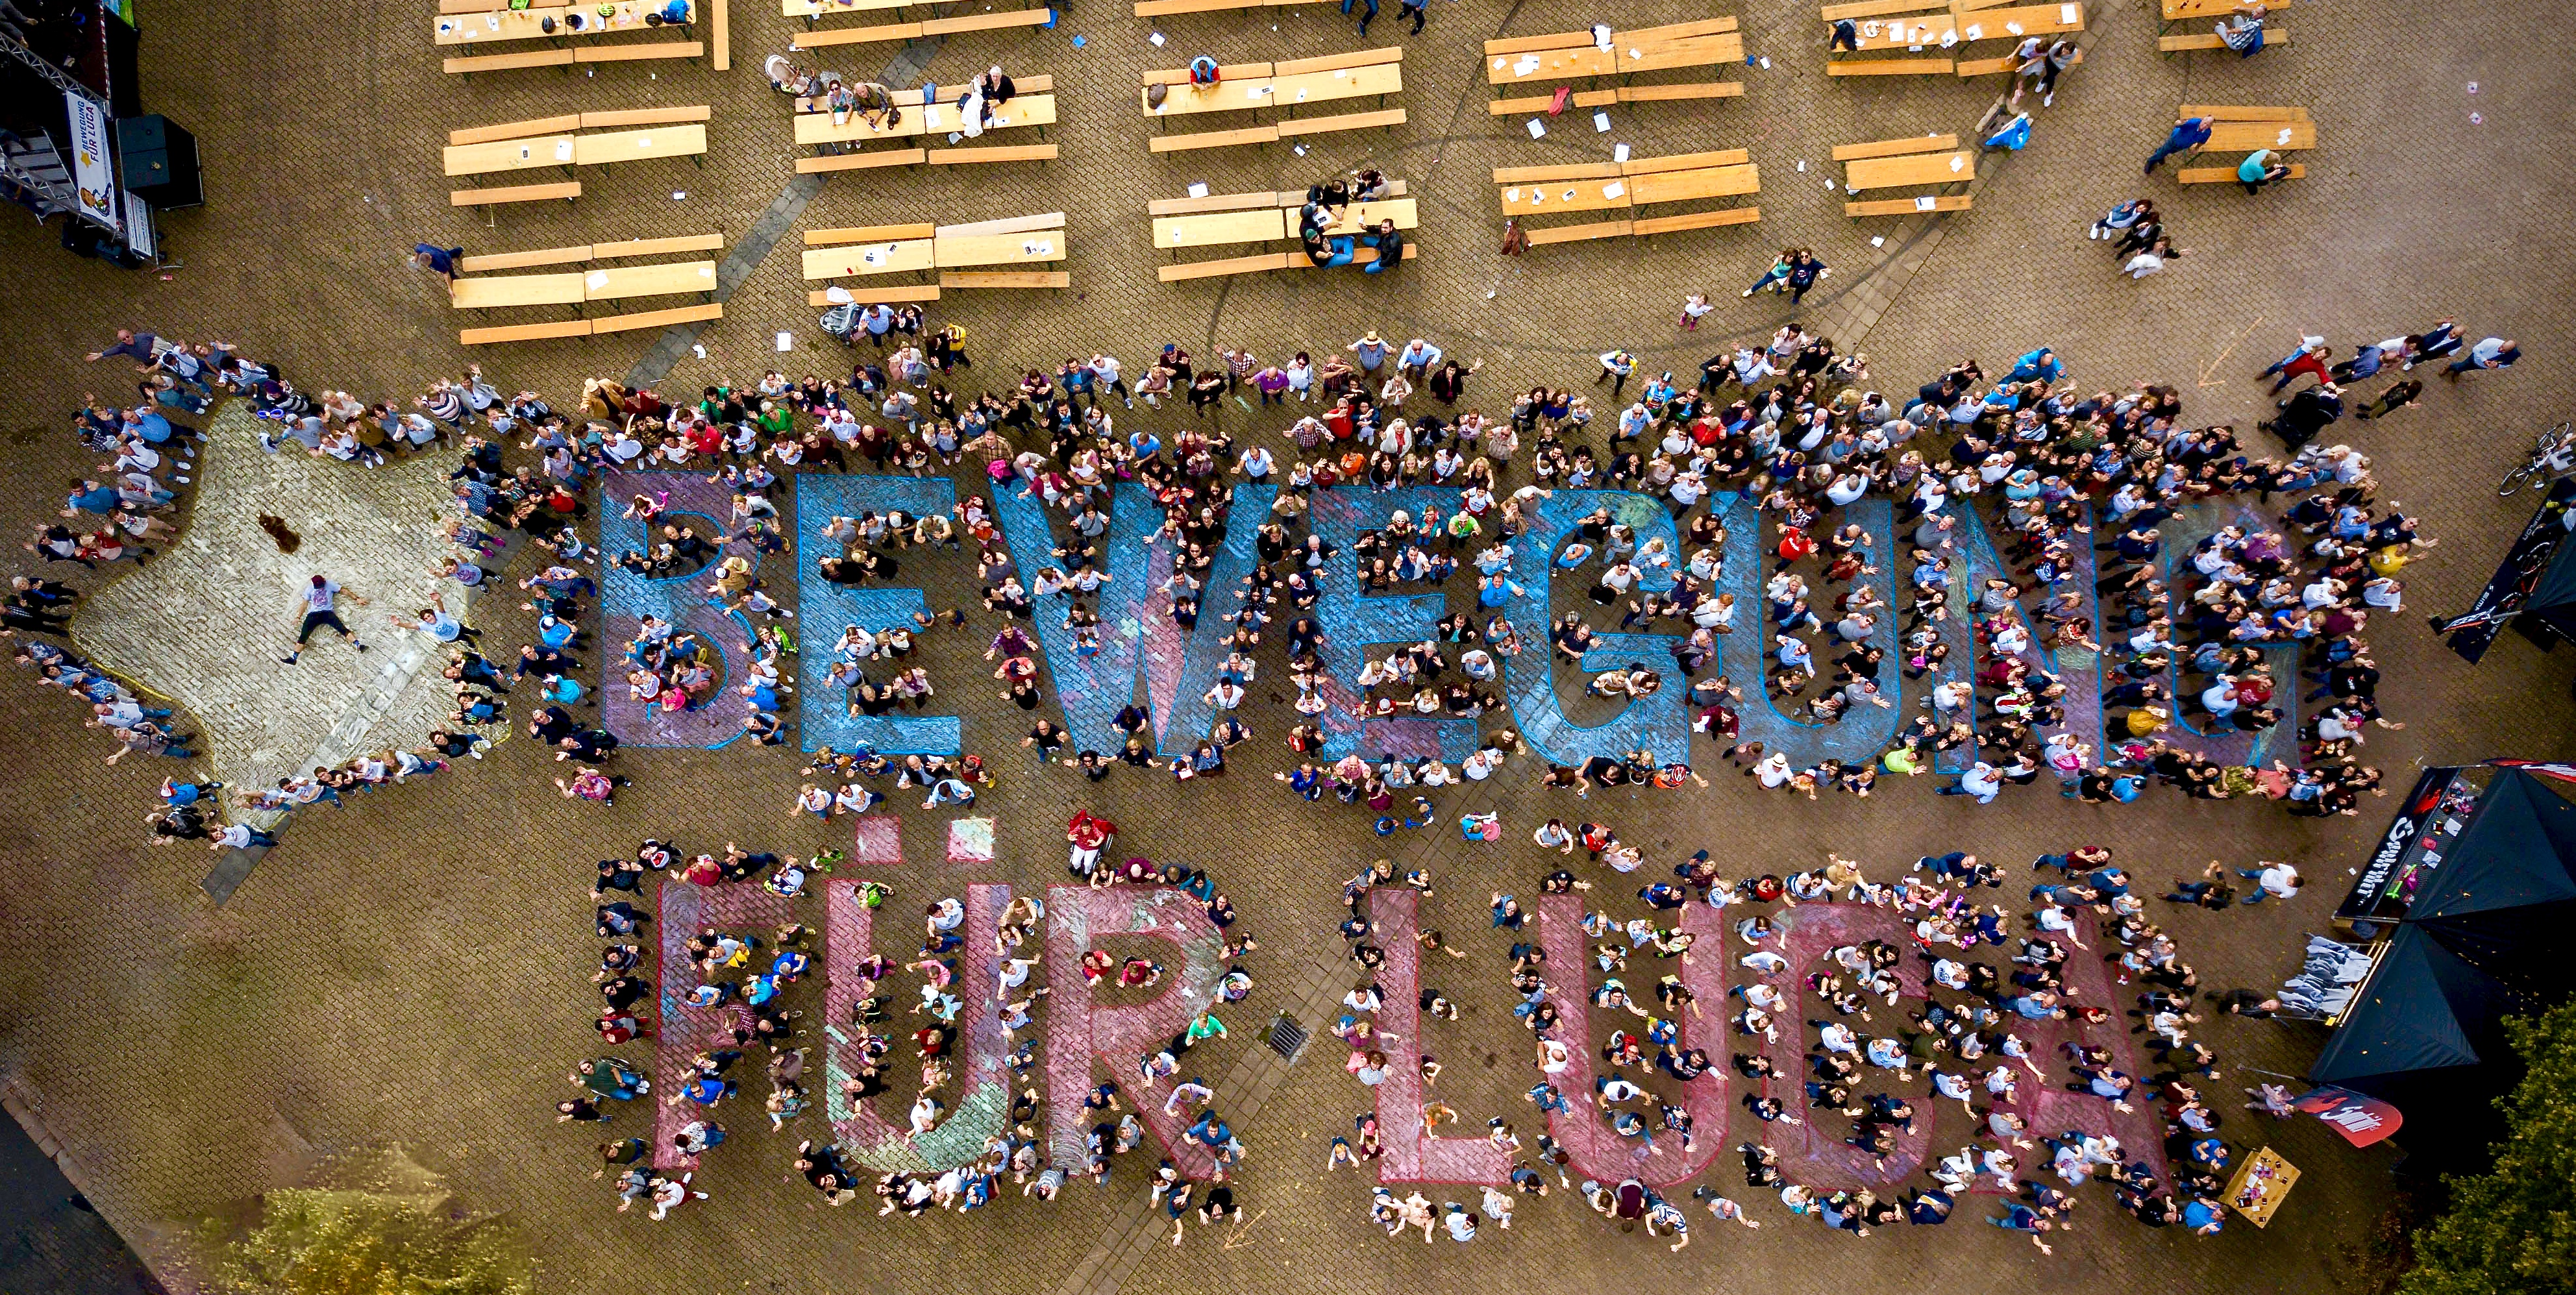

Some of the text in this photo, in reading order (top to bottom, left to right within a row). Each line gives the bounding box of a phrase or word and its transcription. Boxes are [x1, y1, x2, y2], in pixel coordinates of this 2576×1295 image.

[77, 101, 88, 150] BEWEGUNG
[86, 106, 99, 162] FÜR LUCA
[601, 471, 2303, 772] BEWEGUNG
[652, 815, 2179, 1203] FÜR LUCA
